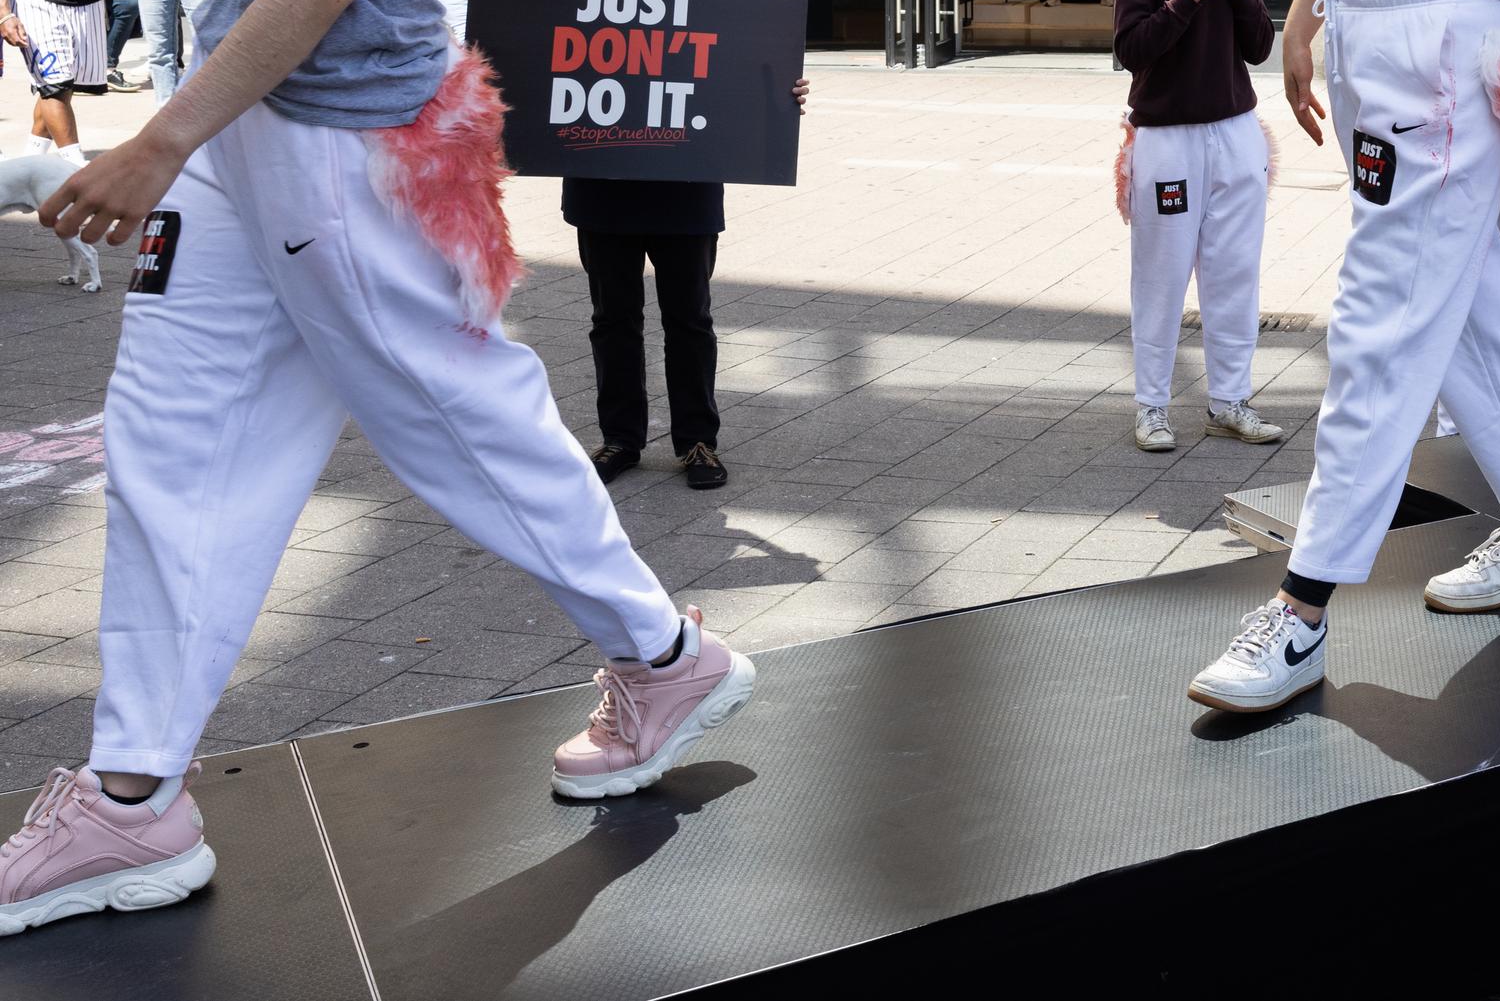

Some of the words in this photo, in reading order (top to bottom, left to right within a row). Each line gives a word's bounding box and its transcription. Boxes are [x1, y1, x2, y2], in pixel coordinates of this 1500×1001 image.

[551, 26, 718, 78] DON'T
[550, 77, 626, 126] DO
[647, 81, 707, 130] IT.
[557, 126, 686, 144] #StopCruelWool
[1361, 141, 1382, 158] JUST
[1357, 166, 1366, 180] DO
[1368, 171, 1380, 186] IT.
[1164, 184, 1179, 192] JUST
